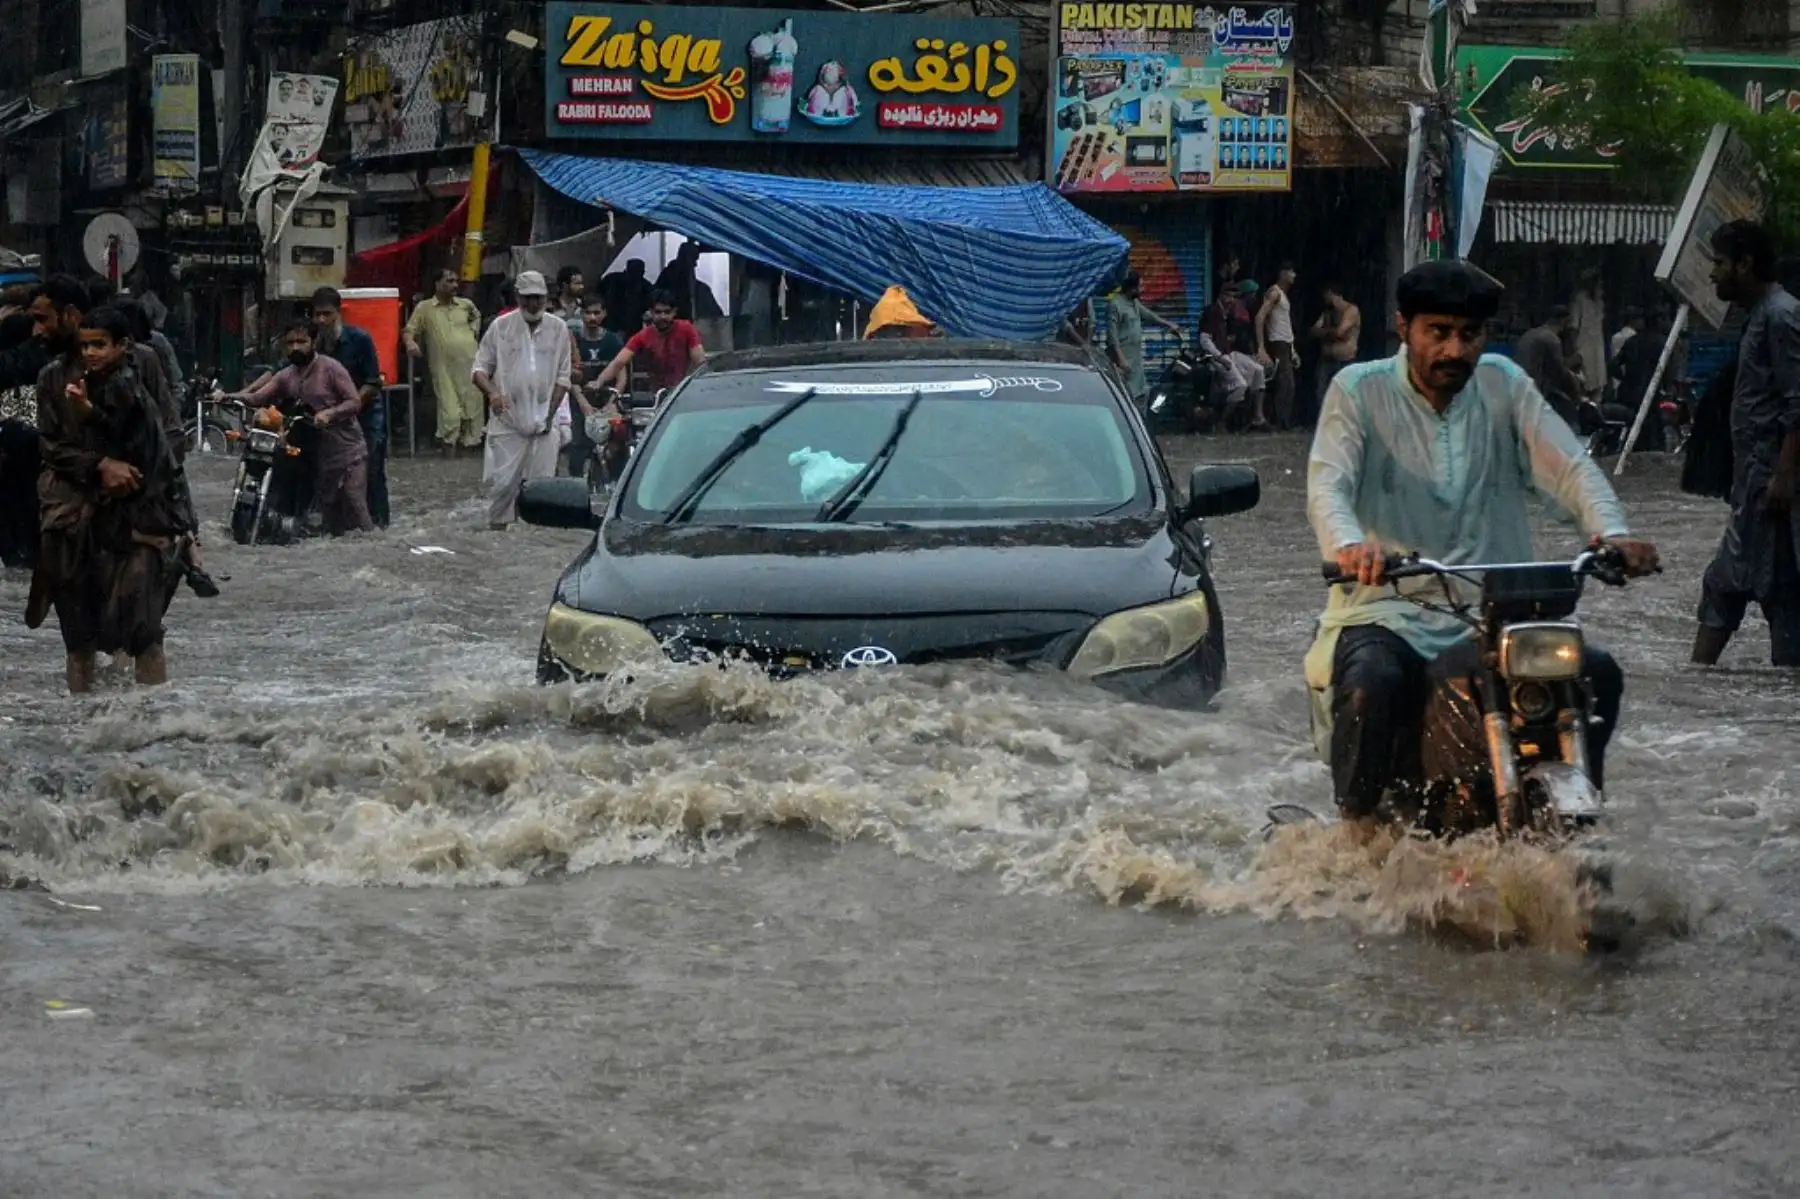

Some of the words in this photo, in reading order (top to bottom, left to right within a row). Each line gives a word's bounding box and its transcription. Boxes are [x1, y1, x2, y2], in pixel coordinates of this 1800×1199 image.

[1061, 4, 1193, 29] PAKISTAN
[1213, 6, 1294, 52] پاکستان
[560, 15, 722, 83] Zaiqa
[572, 77, 633, 93] MEHRAN
[868, 37, 1017, 98] ذائقہ
[558, 104, 596, 119] RABRI
[598, 104, 651, 119] FALOODA
